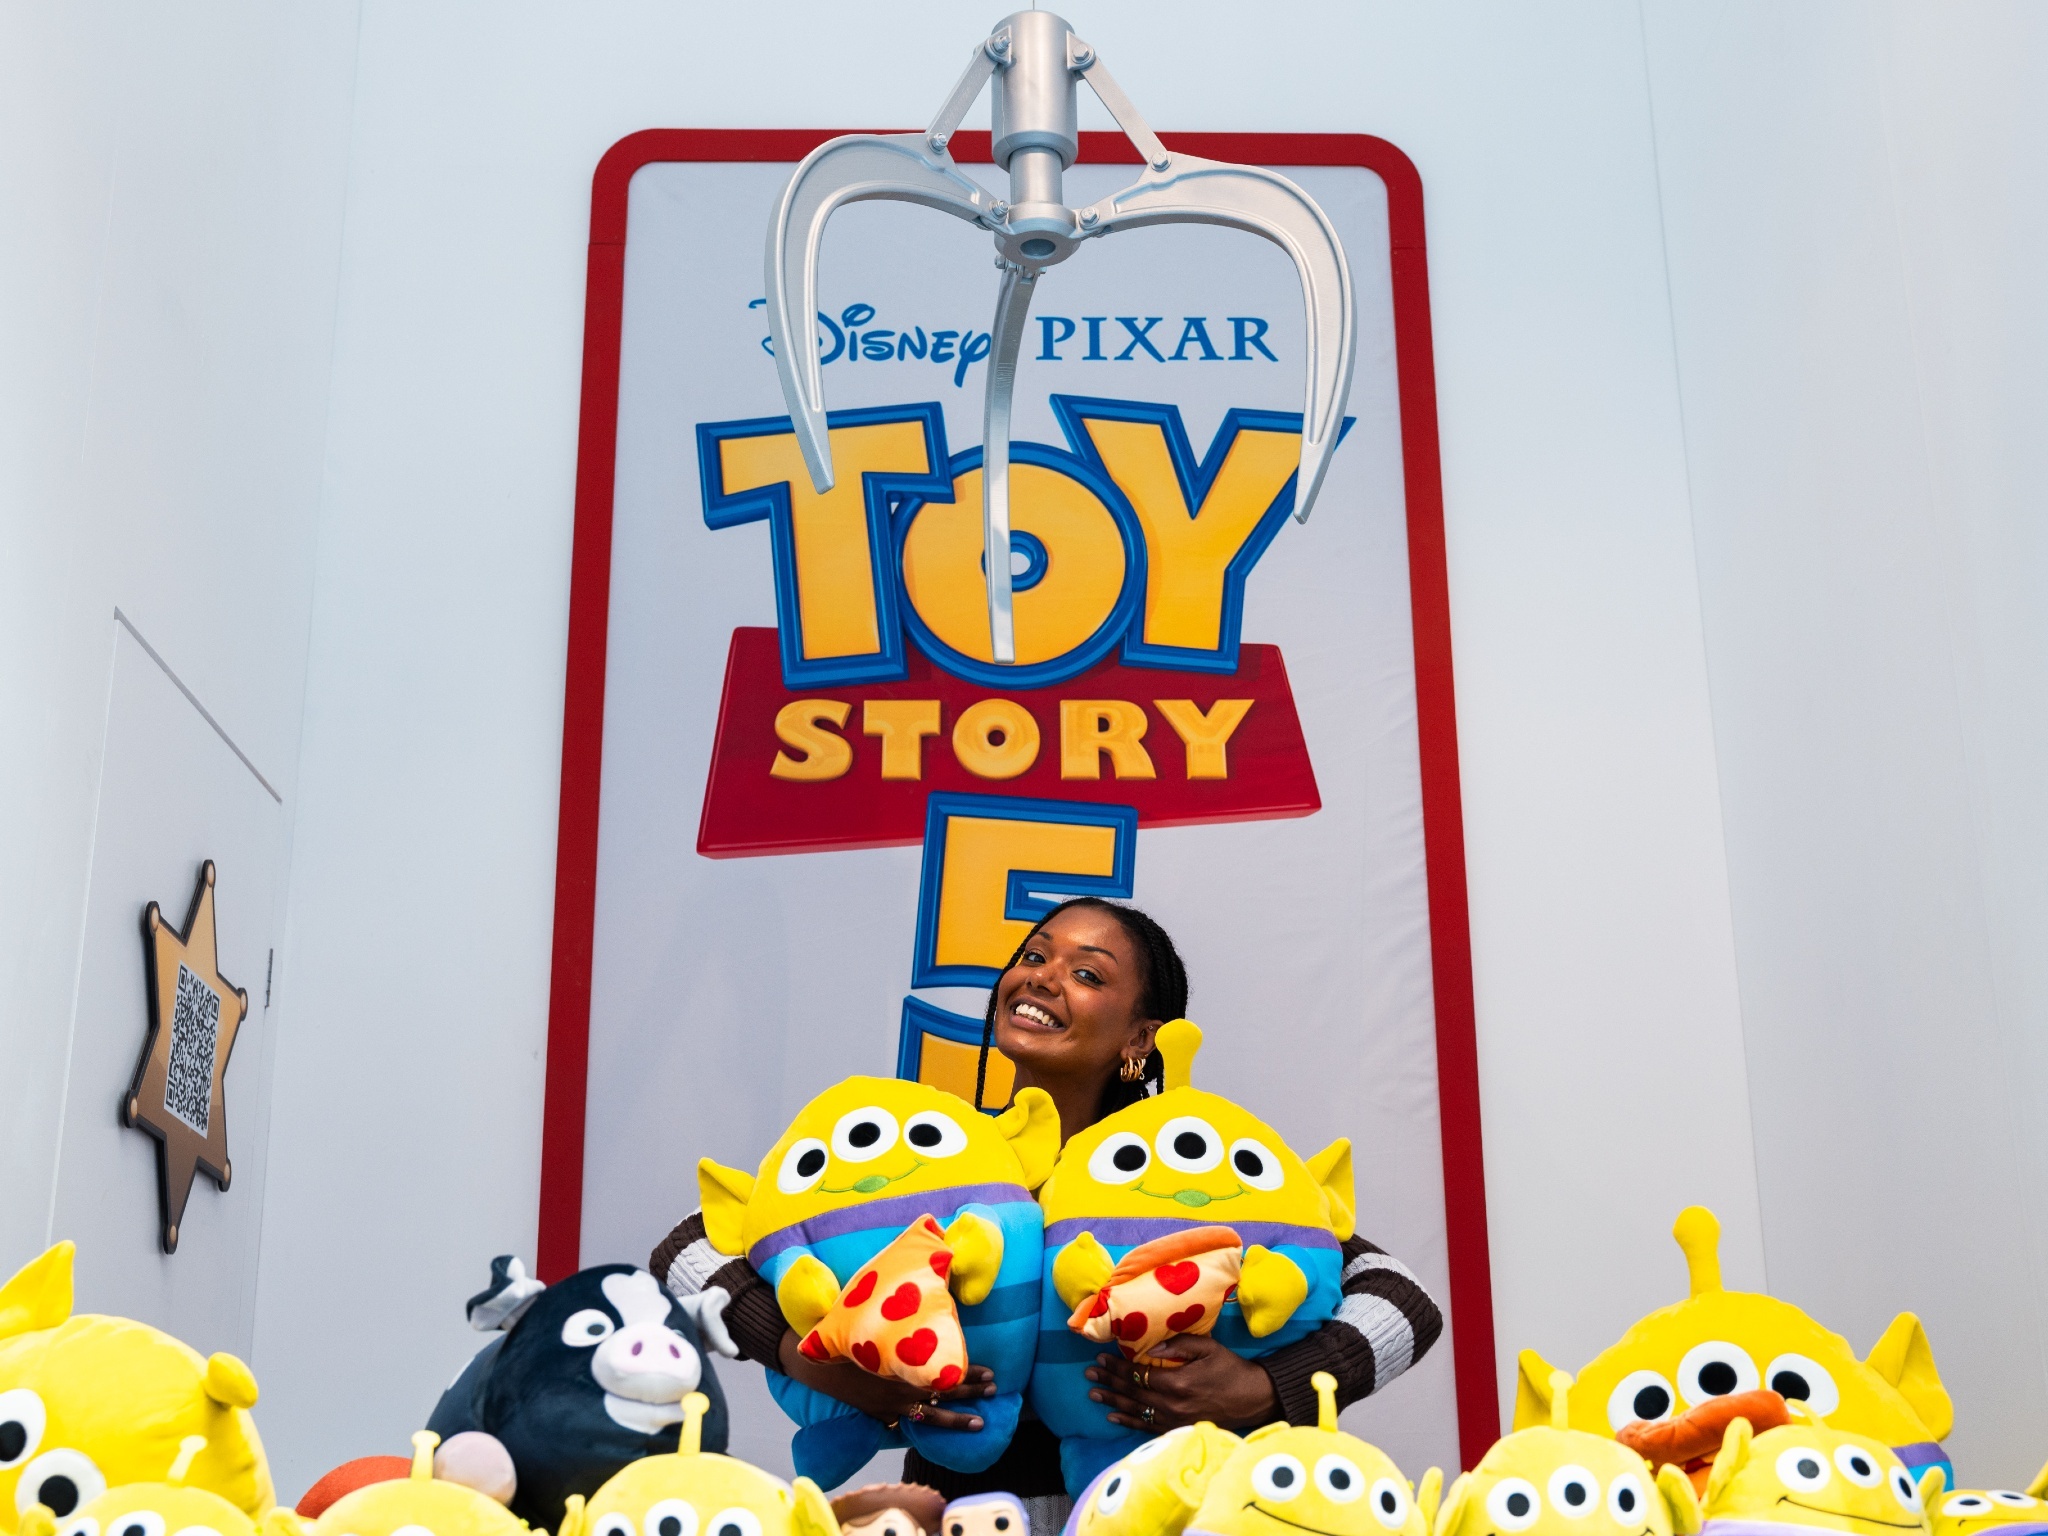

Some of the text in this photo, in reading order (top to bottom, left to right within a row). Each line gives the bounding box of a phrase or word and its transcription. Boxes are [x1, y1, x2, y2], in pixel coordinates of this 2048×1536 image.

[1035, 316, 1279, 362] PIXAR
[695, 394, 1357, 690] TOY
[769, 698, 1255, 783] STORY
